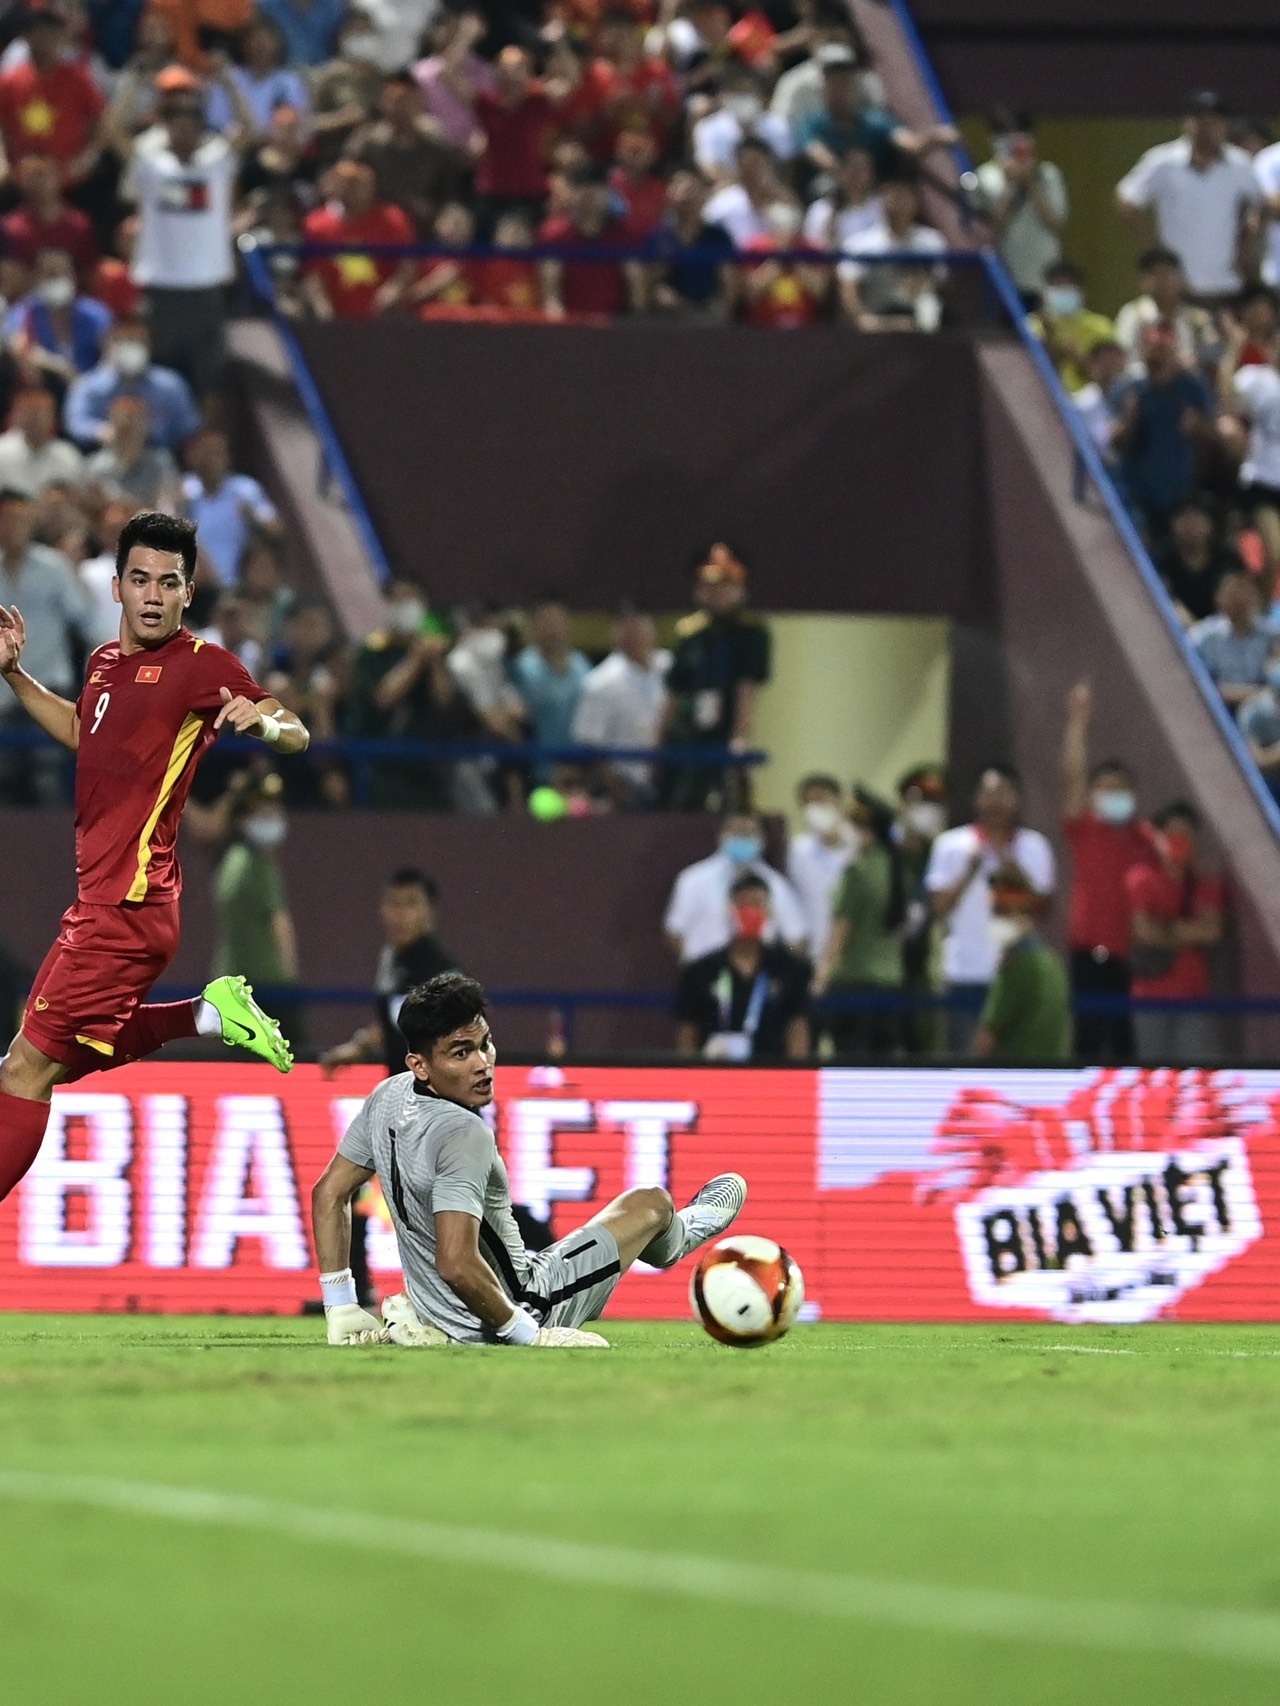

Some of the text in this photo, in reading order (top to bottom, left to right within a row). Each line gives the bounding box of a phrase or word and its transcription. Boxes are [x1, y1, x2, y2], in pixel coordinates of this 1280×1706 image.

[89, 691, 111, 735] 9
[18, 1091, 312, 1270] BIA
[982, 1193, 1093, 1284] BIA
